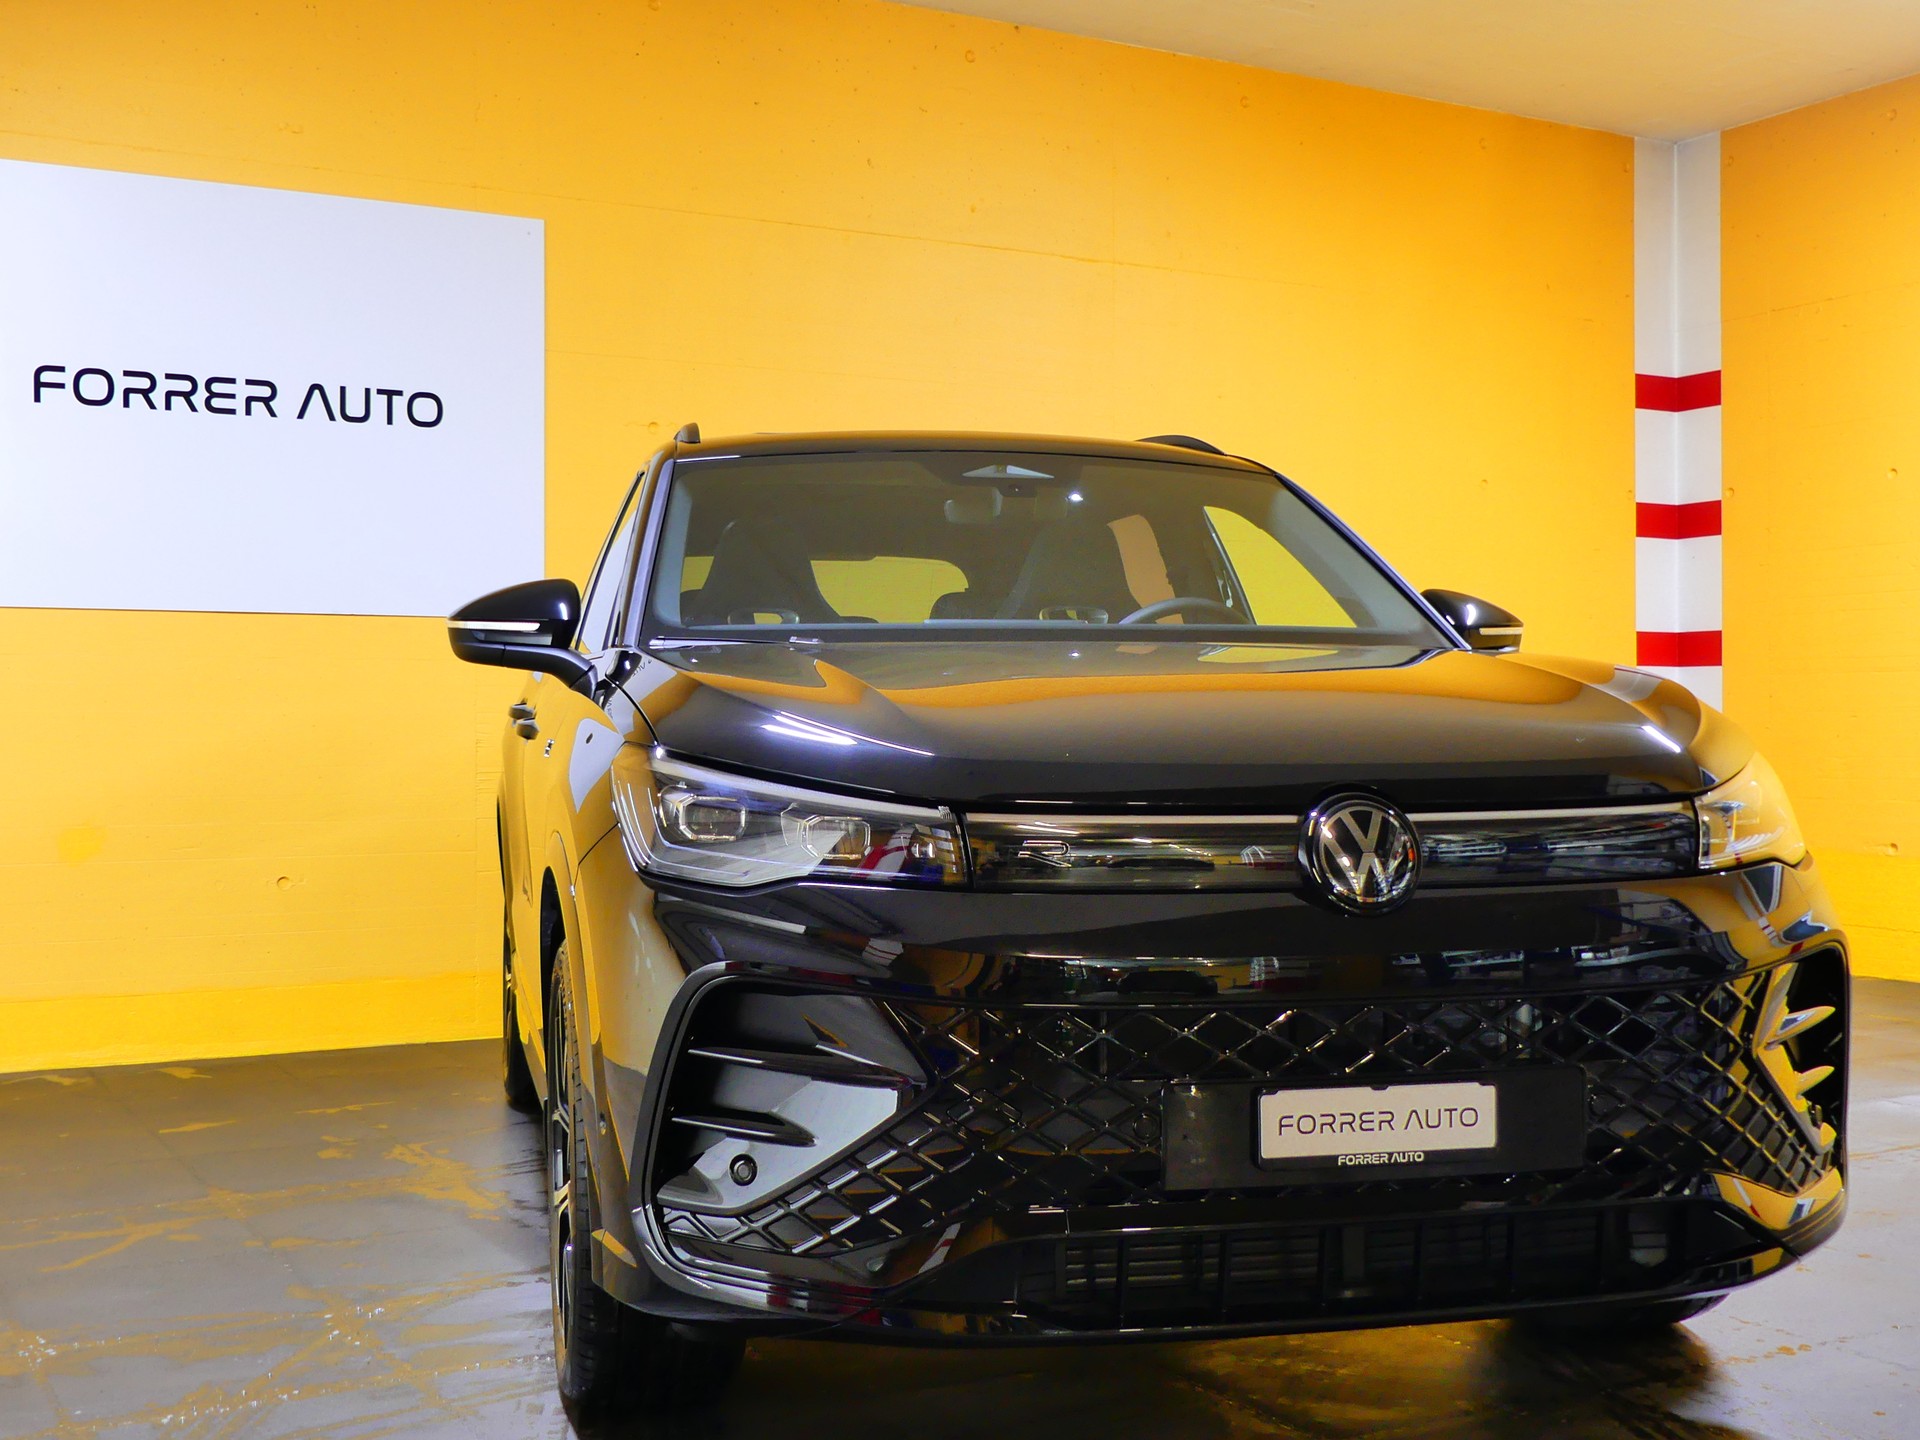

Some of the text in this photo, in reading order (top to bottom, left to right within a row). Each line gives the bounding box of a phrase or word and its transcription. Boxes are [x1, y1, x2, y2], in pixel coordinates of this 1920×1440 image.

[33, 364, 444, 428] FORRER AUTO
[1278, 1106, 1479, 1137] FORRER AUTO
[1337, 1150, 1425, 1166] FORRER AUTO
